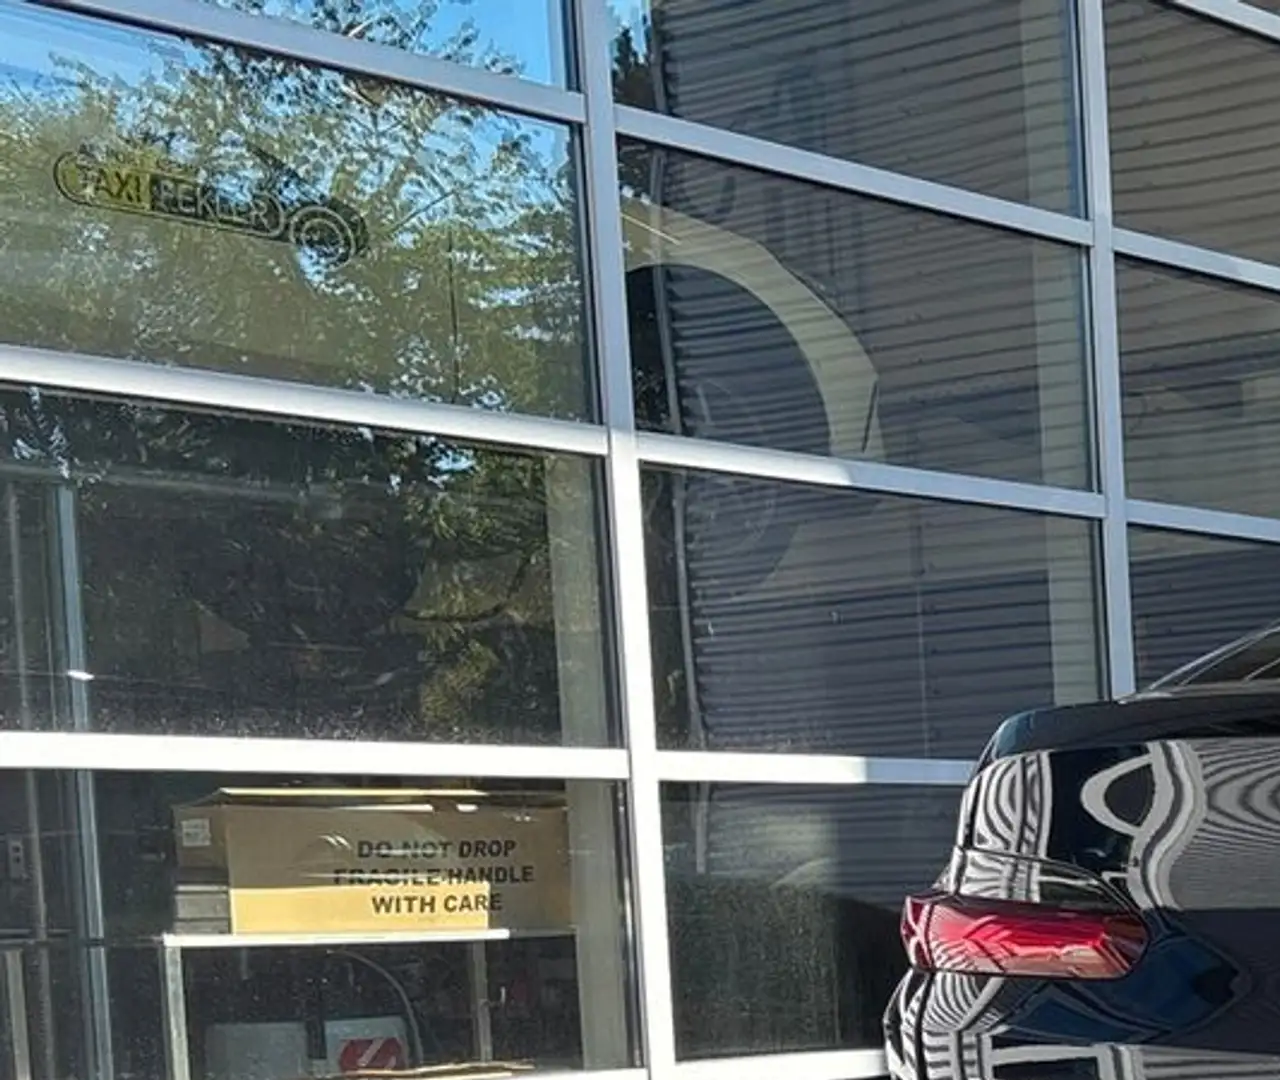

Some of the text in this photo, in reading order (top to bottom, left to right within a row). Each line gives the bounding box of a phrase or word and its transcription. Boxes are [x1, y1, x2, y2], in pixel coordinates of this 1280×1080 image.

[357, 840, 516, 858] DO NOT DROP
[334, 866, 534, 886] FRAGILE HANDLE
[371, 894, 503, 913] WITH CARE
